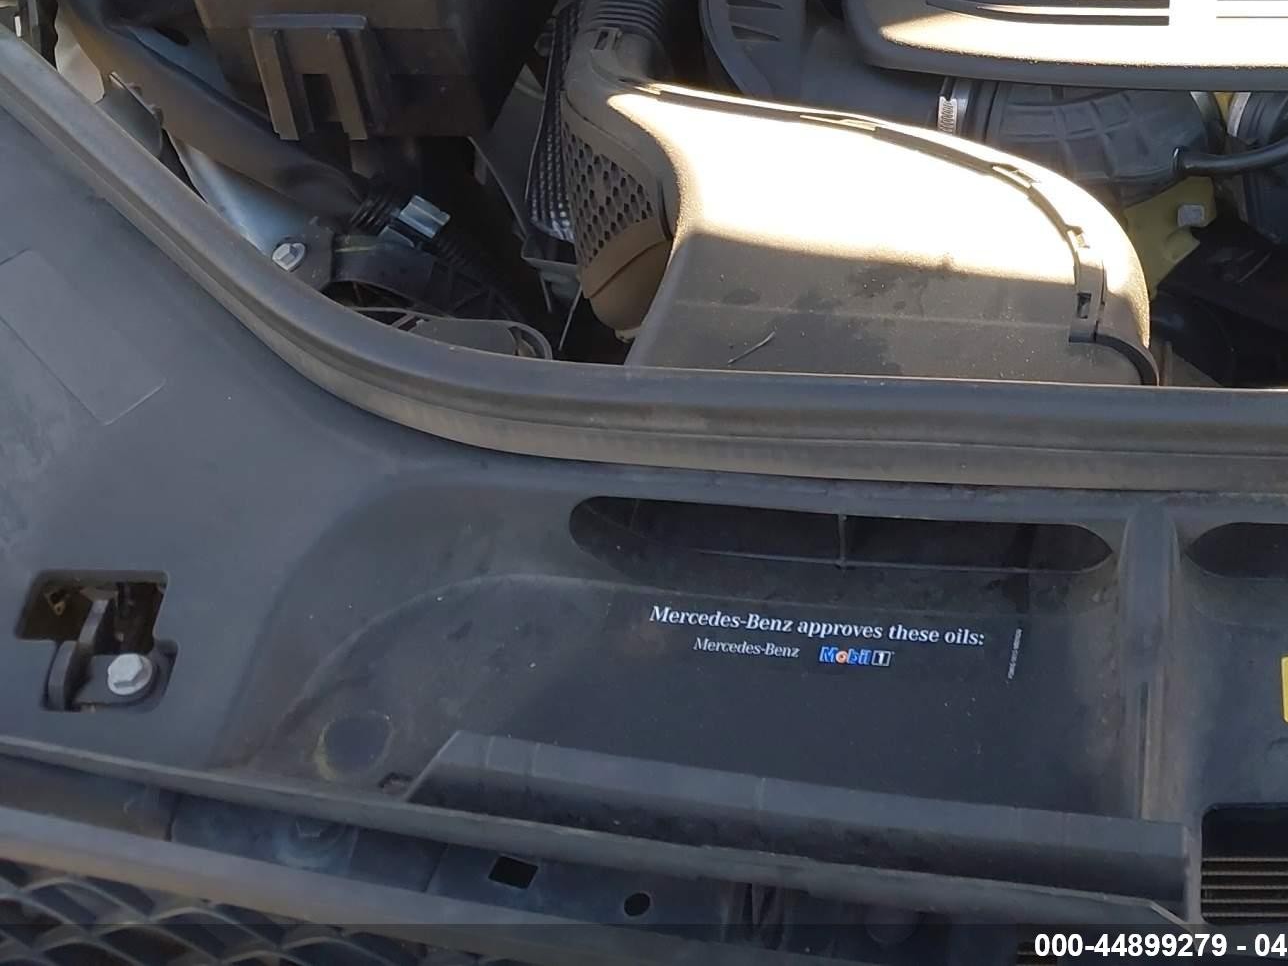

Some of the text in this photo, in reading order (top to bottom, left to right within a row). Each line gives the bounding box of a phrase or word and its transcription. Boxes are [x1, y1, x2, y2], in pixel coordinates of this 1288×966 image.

[649, 605, 985, 646] Mercedes-Benz approves these oils:
[693, 637, 800, 658] Mercedes-Benz
[819, 646, 872, 665] Mobil
